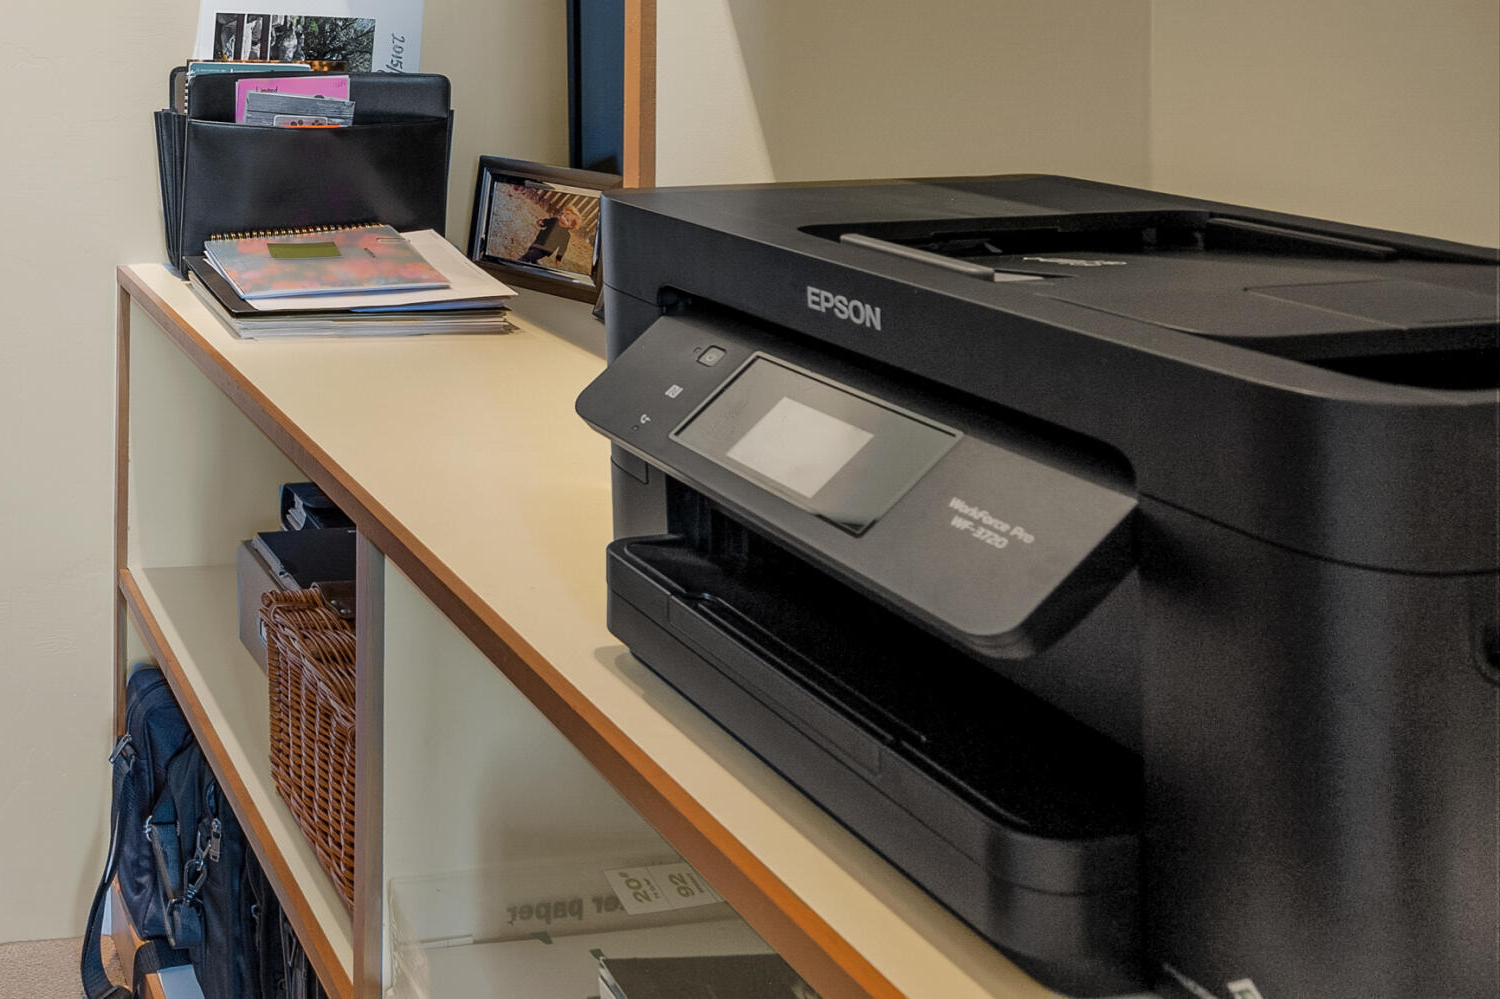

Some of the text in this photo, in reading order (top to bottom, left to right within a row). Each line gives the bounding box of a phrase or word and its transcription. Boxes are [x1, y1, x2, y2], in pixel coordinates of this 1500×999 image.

[806, 285, 882, 331] EPSON
[949, 497, 1035, 544] WorkForce Pro
[950, 515, 1009, 549] WF-3720
